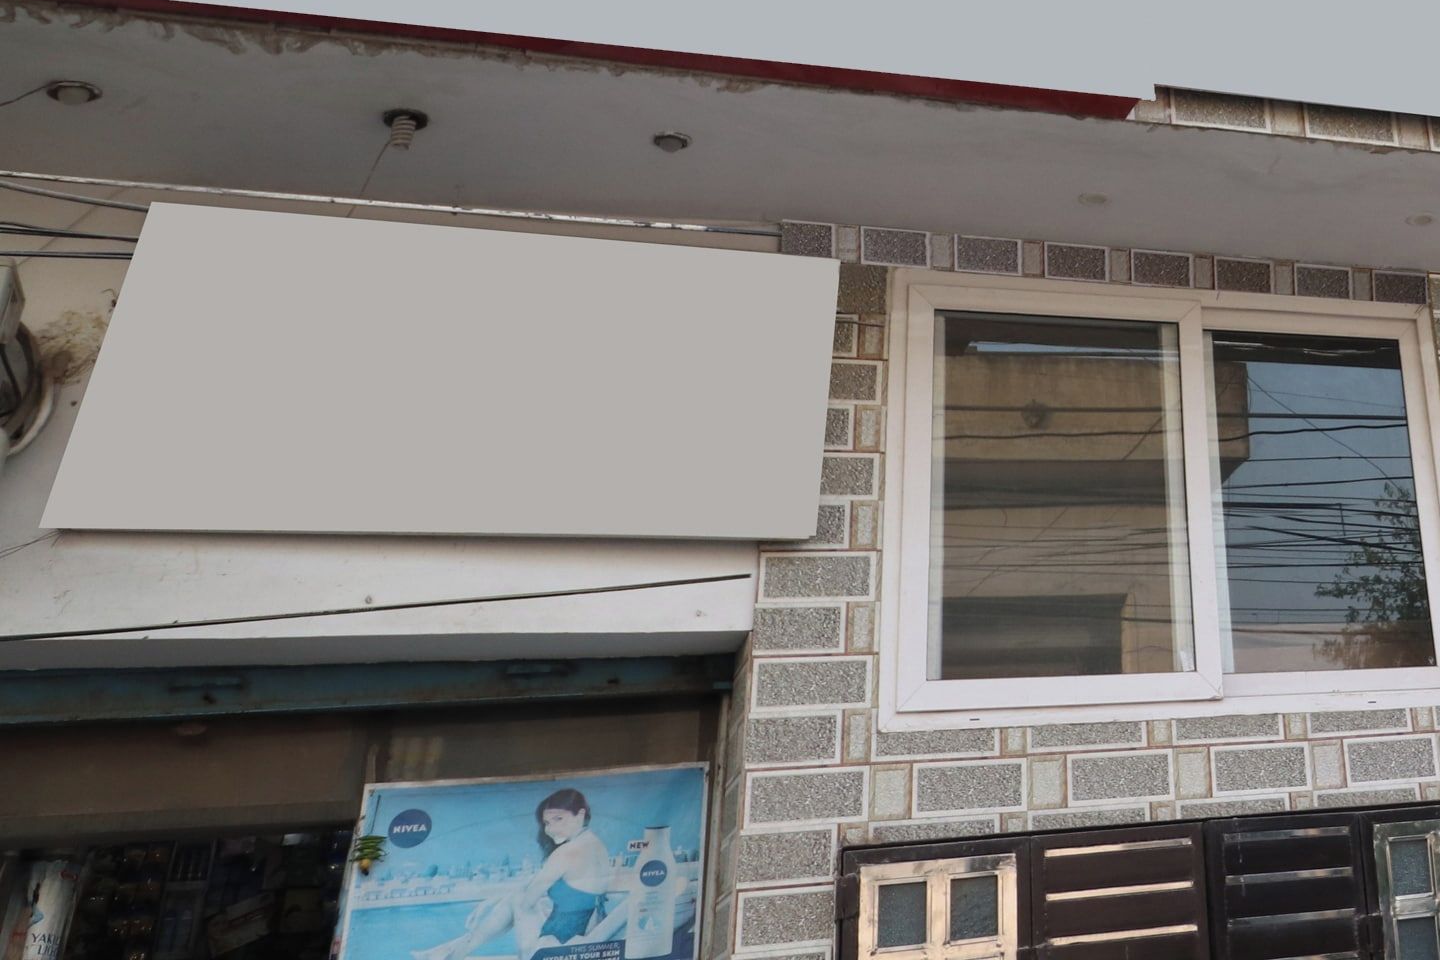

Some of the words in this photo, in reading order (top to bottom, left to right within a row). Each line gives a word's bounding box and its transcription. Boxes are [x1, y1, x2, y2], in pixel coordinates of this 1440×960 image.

[392, 824, 427, 834] NIVEA
[630, 841, 650, 849] NEW
[580, 951, 601, 959] YOUR
[602, 949, 621, 957] SKIN
